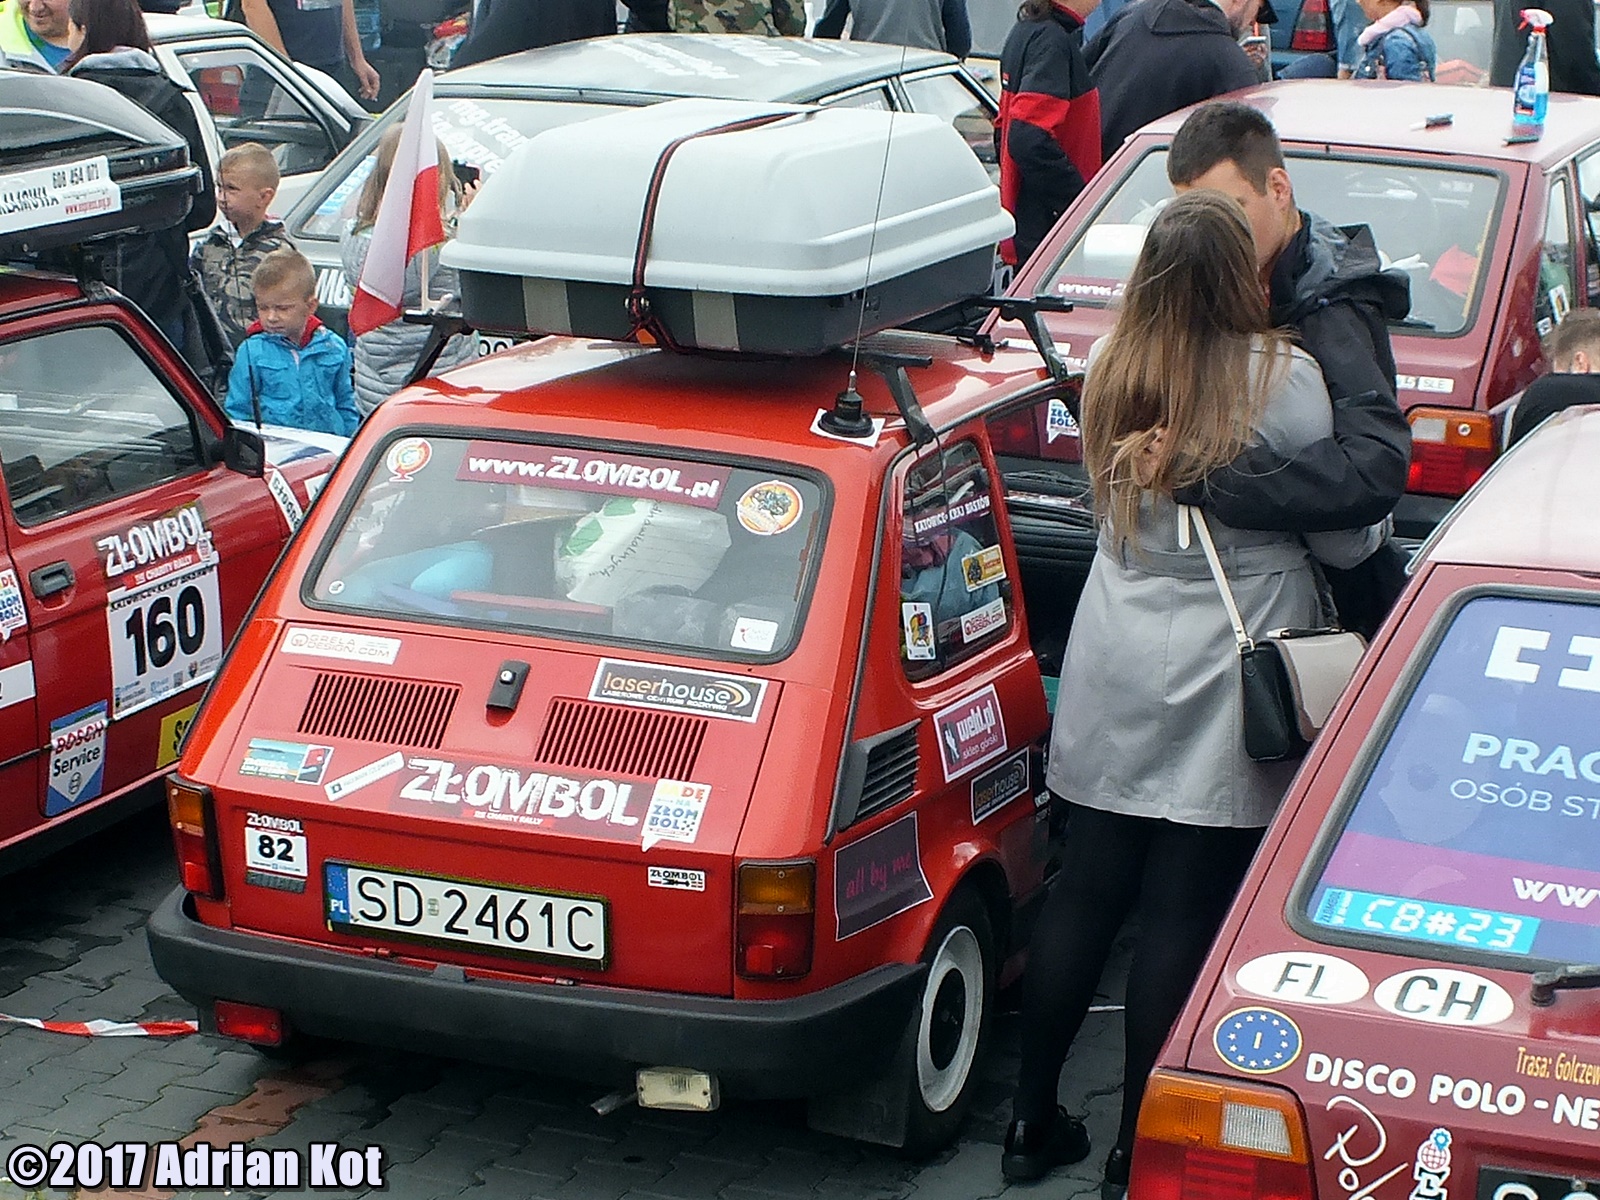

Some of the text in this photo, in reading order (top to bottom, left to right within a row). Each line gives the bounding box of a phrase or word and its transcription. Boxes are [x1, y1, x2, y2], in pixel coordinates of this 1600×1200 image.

[1050, 408, 1070, 418] ZŁO
[96, 506, 213, 577] ZŁOMBOL
[125, 585, 205, 677] 160
[309, 634, 356, 646] GRELA
[307, 641, 390, 658] DESIGN.COM
[604, 671, 731, 704] laserhouse
[55, 720, 105, 754] BOSCH
[962, 731, 999, 760] sklep górski
[52, 745, 101, 777] Service
[399, 756, 640, 827] ZŁOMBOL
[1450, 778, 1553, 812] OSÓB
[246, 812, 305, 834] ZŁOMBOL
[486, 811, 519, 824] CHARITY
[519, 815, 544, 826] RALLY
[649, 816, 681, 830] BOL
[652, 803, 699, 820] ZŁOM
[258, 834, 295, 863] 82
[650, 868, 704, 881] ZŁOMBOL
[870, 861, 888, 892] by
[1512, 876, 1600, 909] ww
[330, 899, 347, 914] PL
[357, 875, 425, 928] SD
[442, 888, 595, 952] 2461C
[1360, 898, 1523, 949] CB#23
[1272, 960, 1330, 1000] FL
[1393, 974, 1488, 1022] CH
[1516, 1046, 1553, 1079] Trasa:
[1305, 1052, 1417, 1099] DISCO
[1428, 1074, 1527, 1116] POLO
